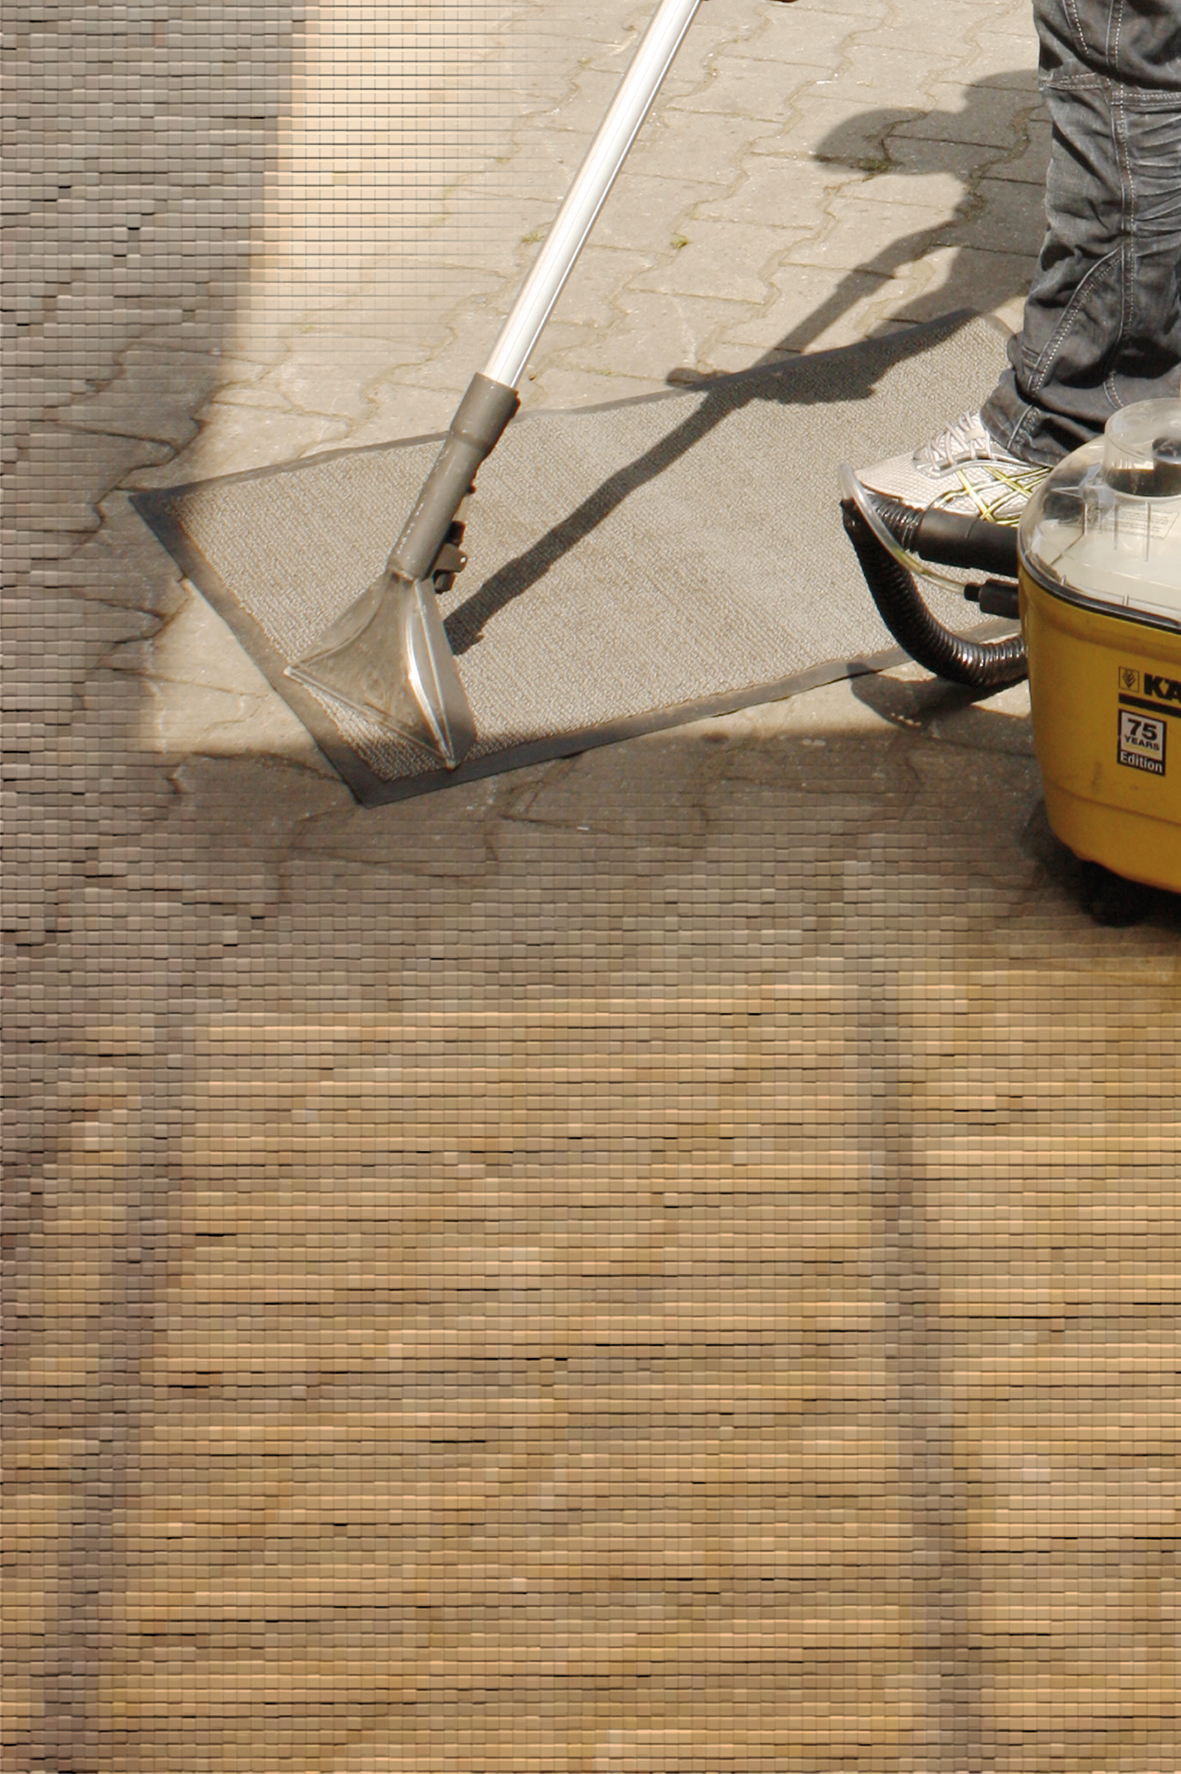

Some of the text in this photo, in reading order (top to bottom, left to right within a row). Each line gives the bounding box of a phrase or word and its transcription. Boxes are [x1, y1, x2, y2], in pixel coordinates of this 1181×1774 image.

[1127, 717, 1158, 741] 75
[1124, 734, 1160, 751] YEARS
[1120, 751, 1163, 774] Edition
